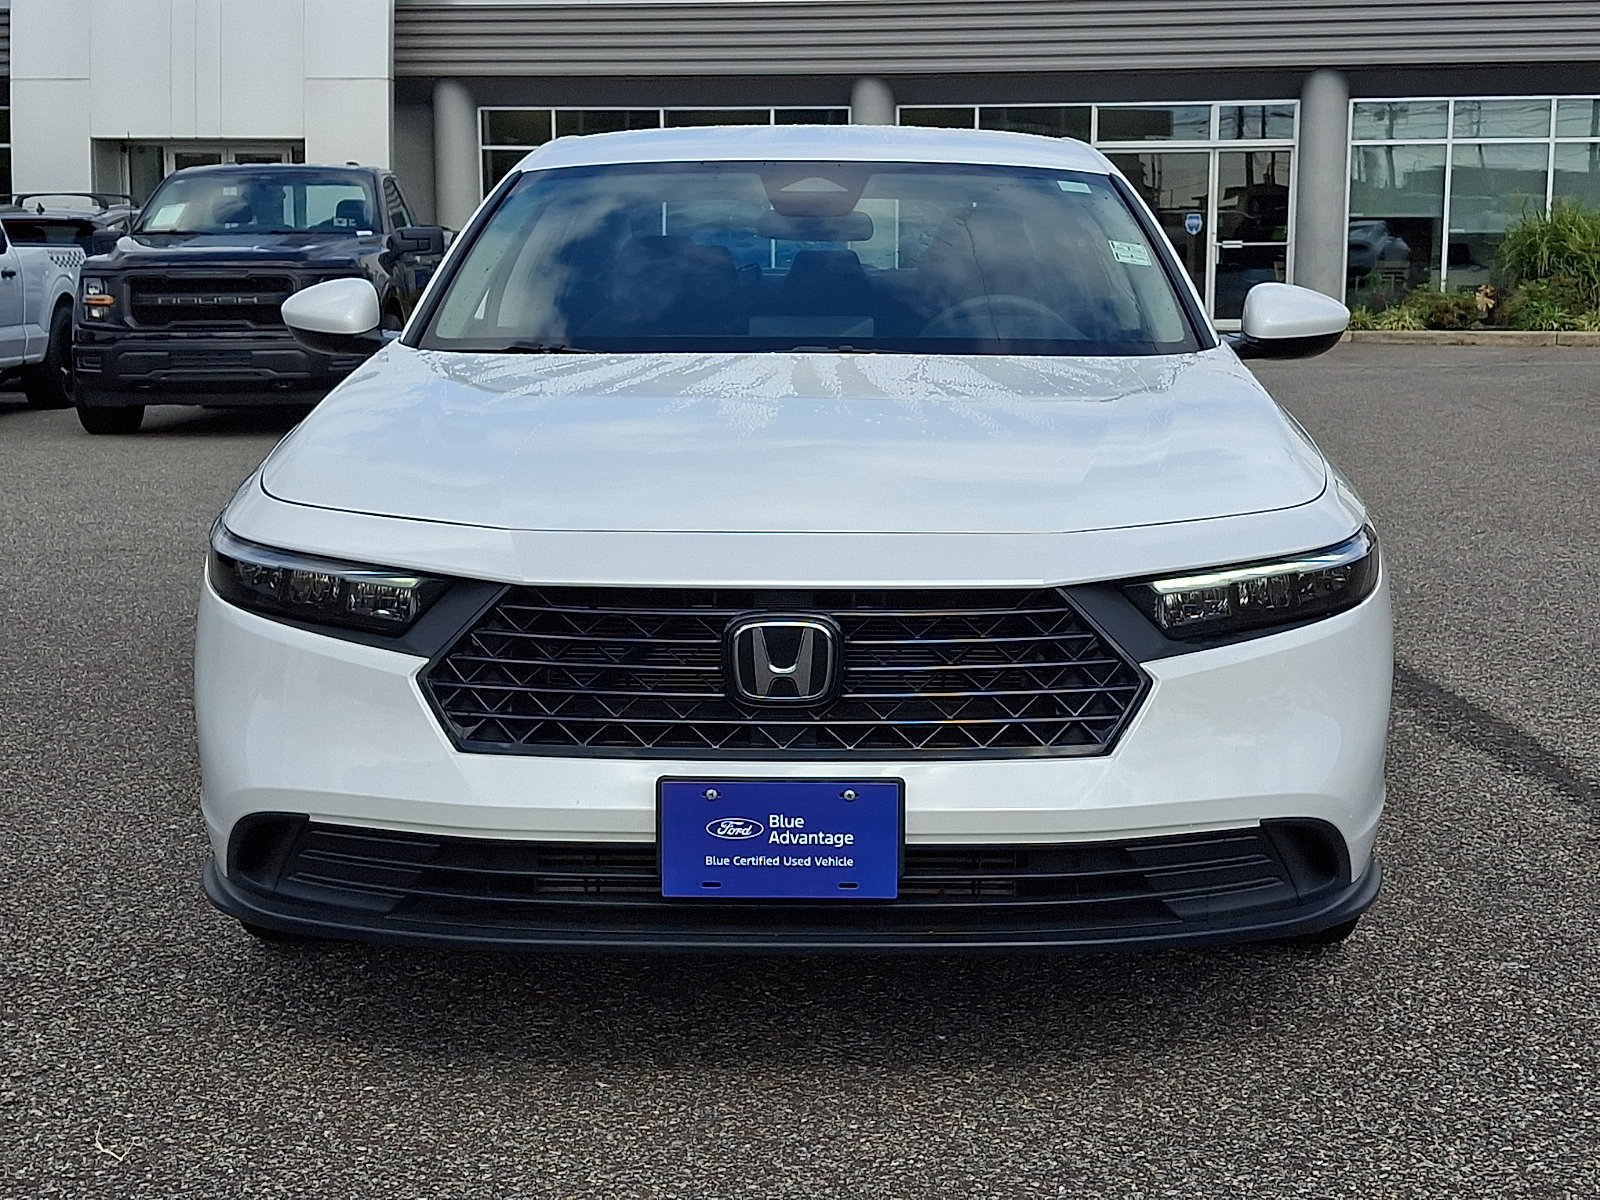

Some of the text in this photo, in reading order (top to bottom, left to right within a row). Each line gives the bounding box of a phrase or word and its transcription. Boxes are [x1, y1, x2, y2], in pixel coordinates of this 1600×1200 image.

[716, 820, 753, 836] Ford
[769, 814, 805, 828] Blue
[769, 831, 854, 847] Advantage
[705, 855, 854, 867] Blue Certified Used Vehicle
